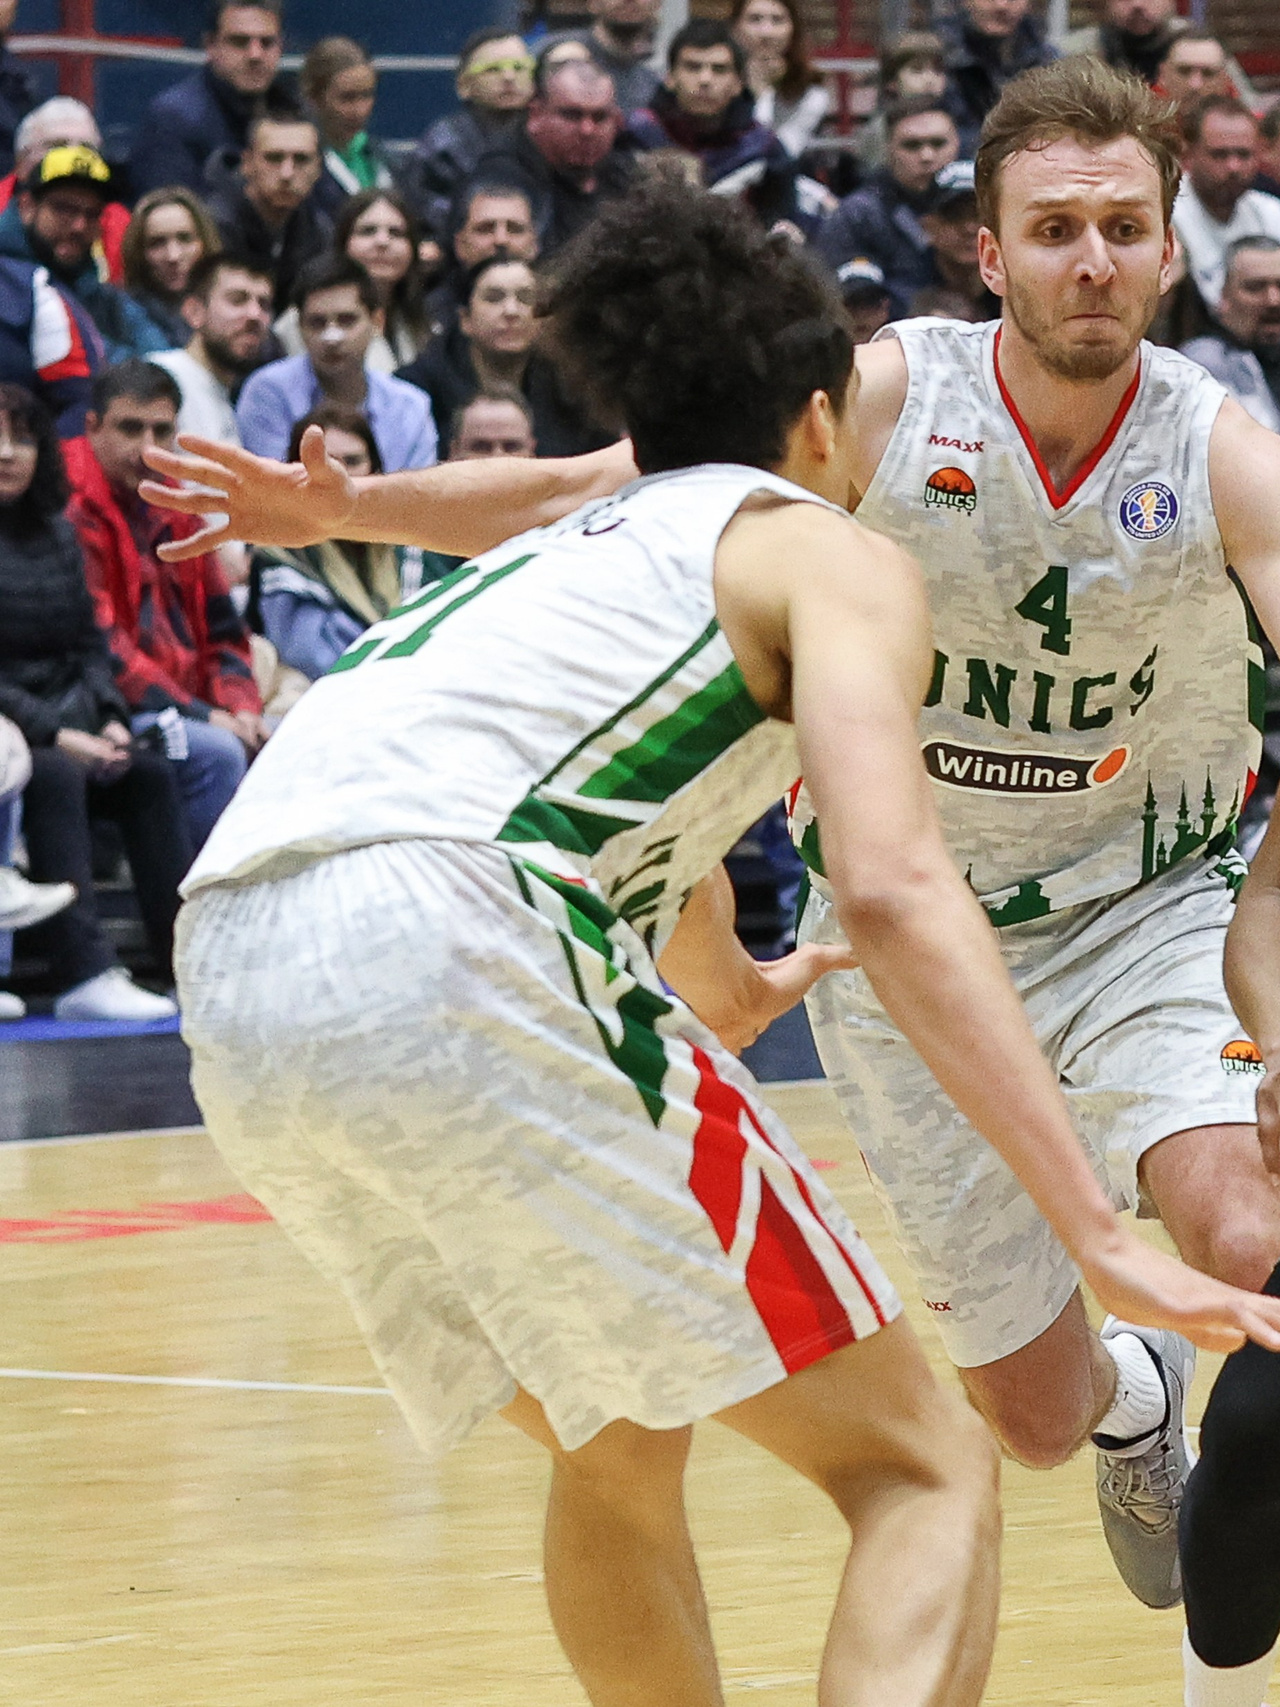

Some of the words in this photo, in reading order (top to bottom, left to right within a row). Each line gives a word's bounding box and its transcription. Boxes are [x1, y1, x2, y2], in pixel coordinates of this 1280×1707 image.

[927, 434, 985, 453] MAXX
[925, 486, 976, 510] UNICS
[1015, 566, 1072, 655] 4
[937, 748, 1079, 789] Winline
[1221, 1058, 1267, 1076] UNICS
